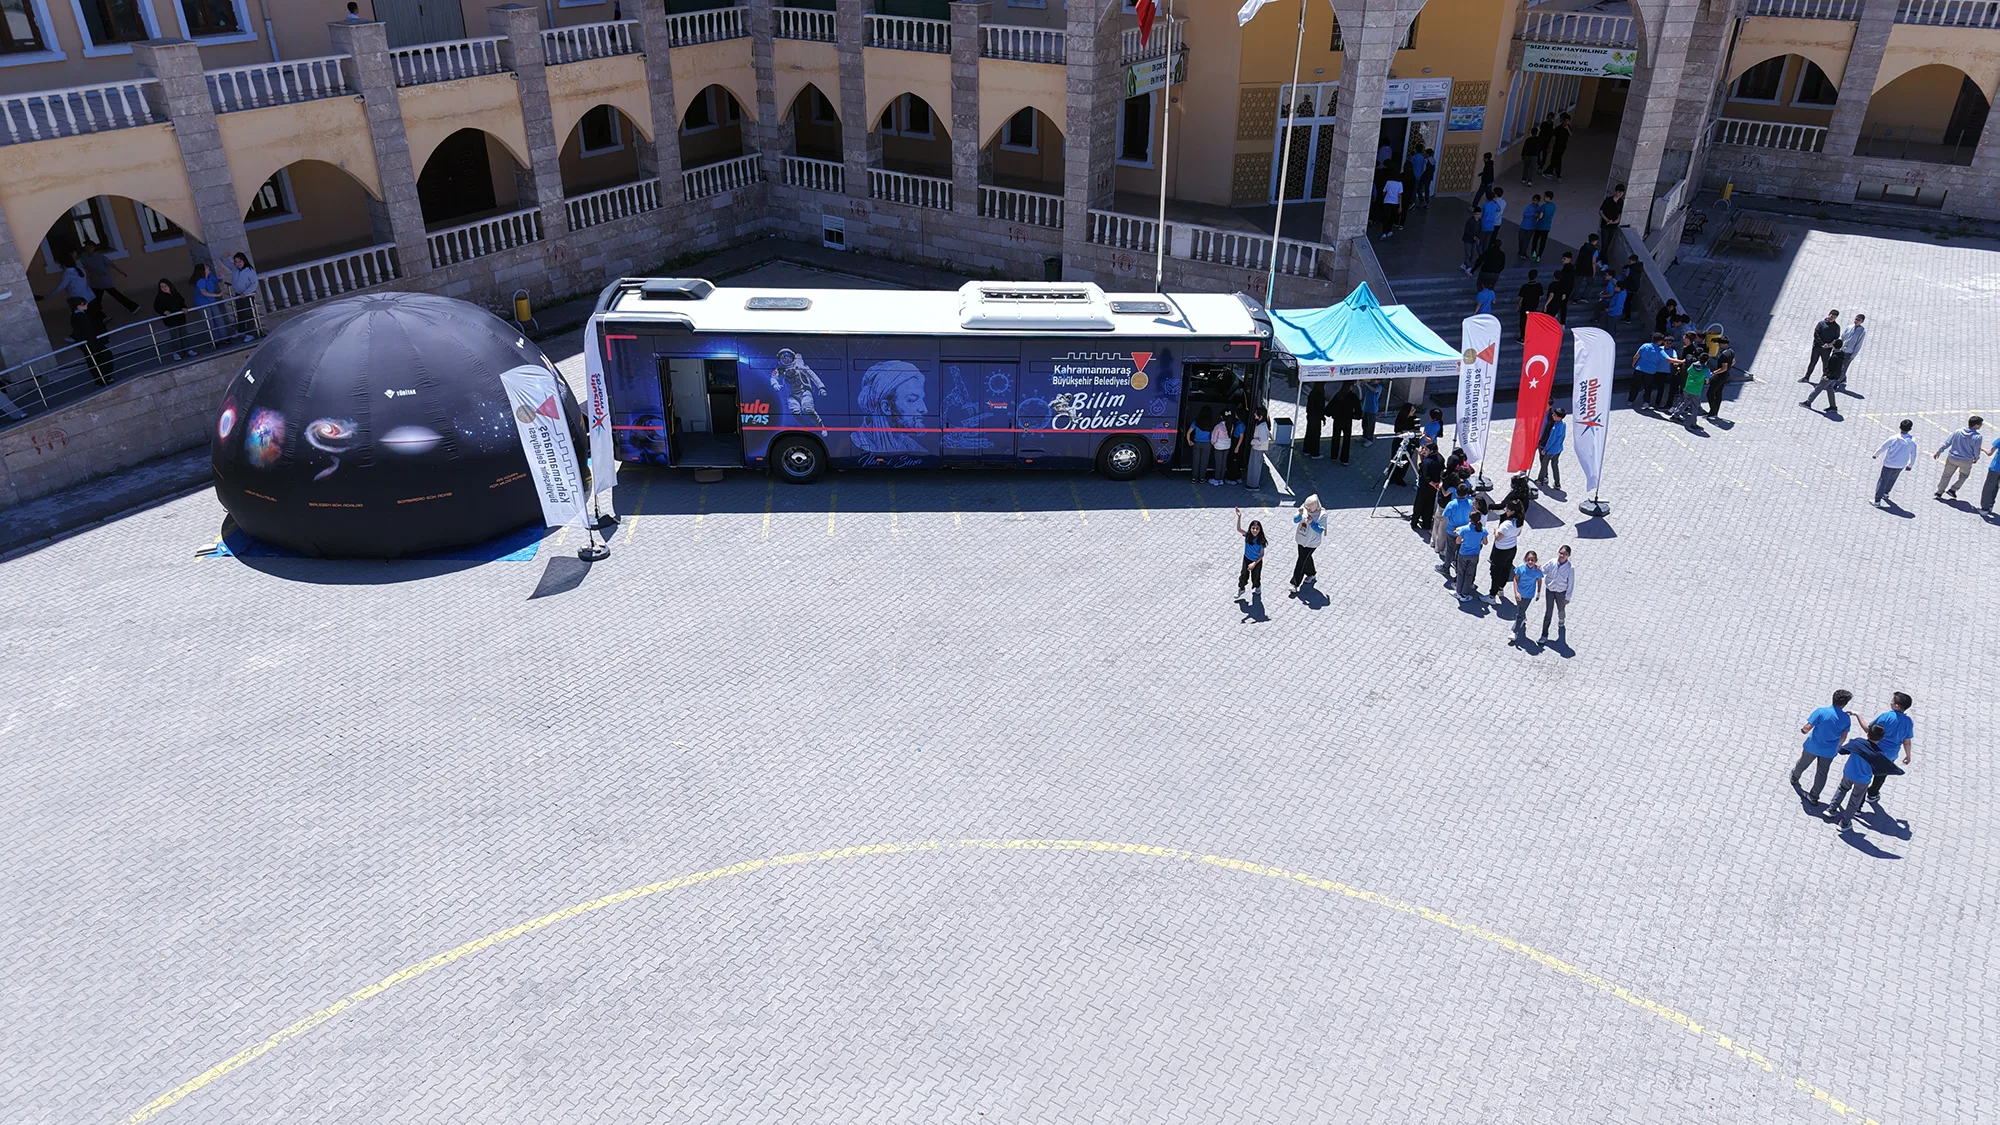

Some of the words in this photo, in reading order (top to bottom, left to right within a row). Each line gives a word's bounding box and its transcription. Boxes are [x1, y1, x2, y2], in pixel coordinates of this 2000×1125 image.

[1054, 364, 1131, 376] Kahramanmaraş
[1339, 366, 1379, 375] Kahramanmaraş
[1380, 363, 1407, 375] Büyükşehir
[1407, 363, 1432, 374] Belediyesi
[1052, 376, 1092, 387] Büyükşehir
[1094, 376, 1131, 387] Belediyesi
[1071, 392, 1126, 410] Bilim
